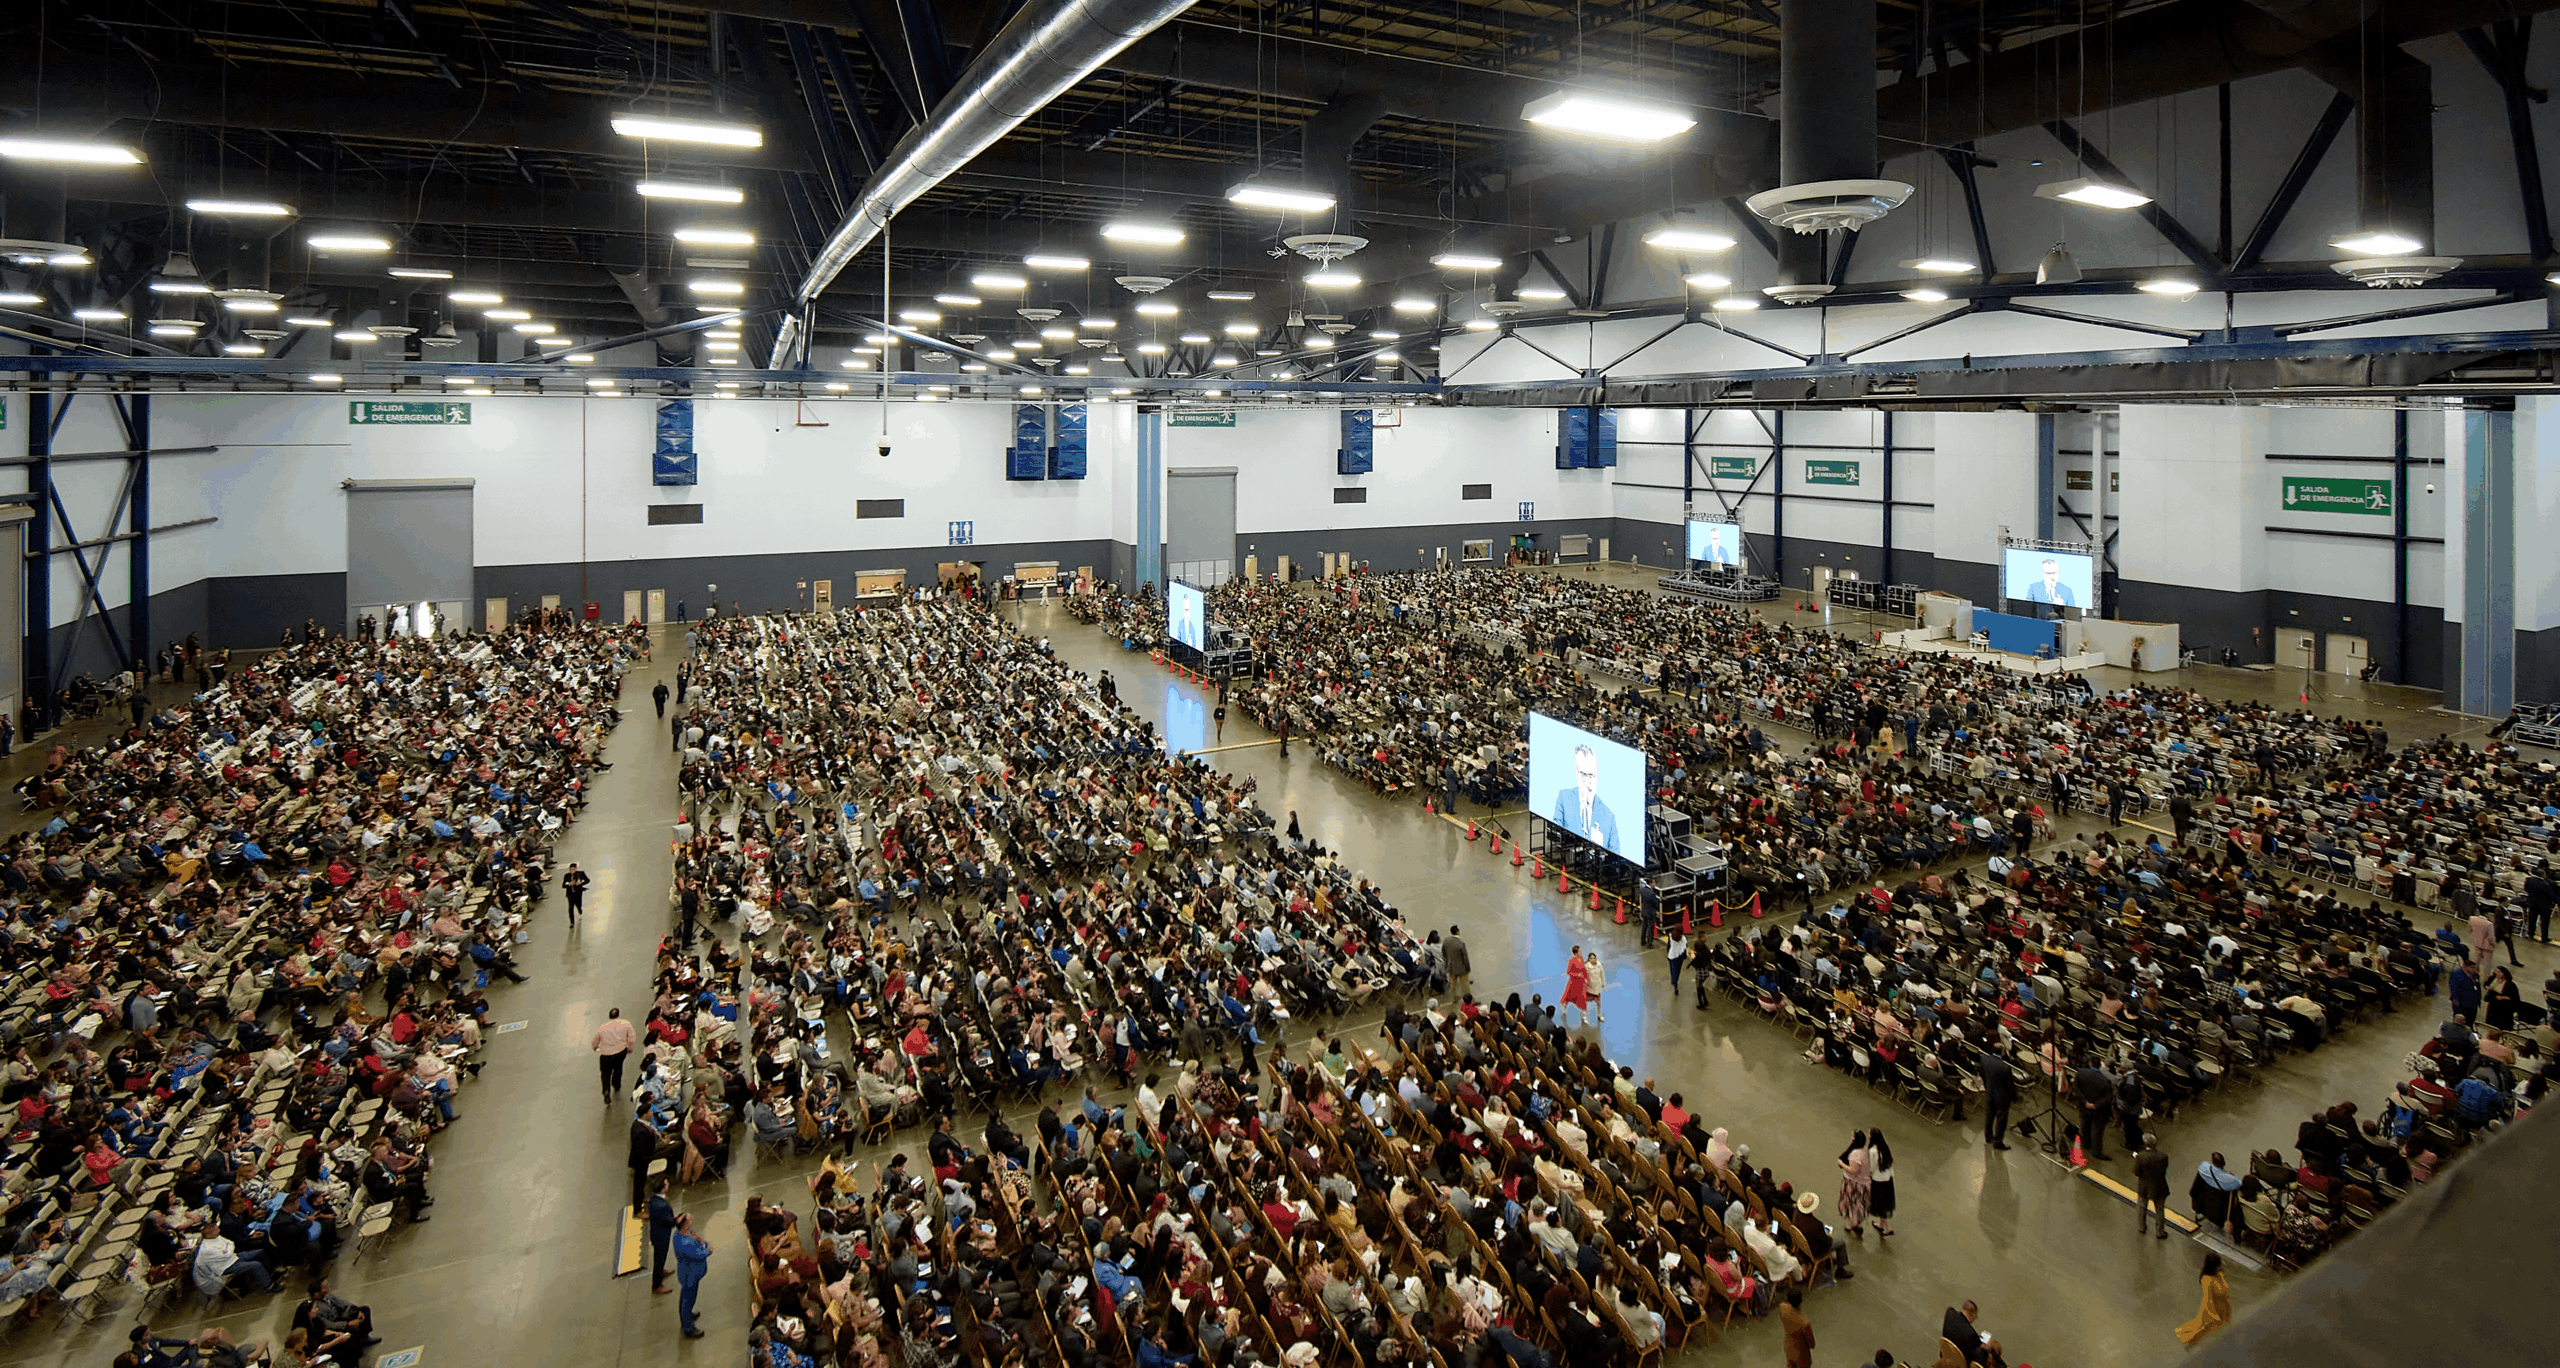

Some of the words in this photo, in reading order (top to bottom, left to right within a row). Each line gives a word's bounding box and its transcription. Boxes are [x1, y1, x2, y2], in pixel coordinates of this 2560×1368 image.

[371, 404, 404, 412] SALIDA
[2300, 486, 2330, 494] SALIDA
[2312, 495, 2365, 504] EMERGENCIA
